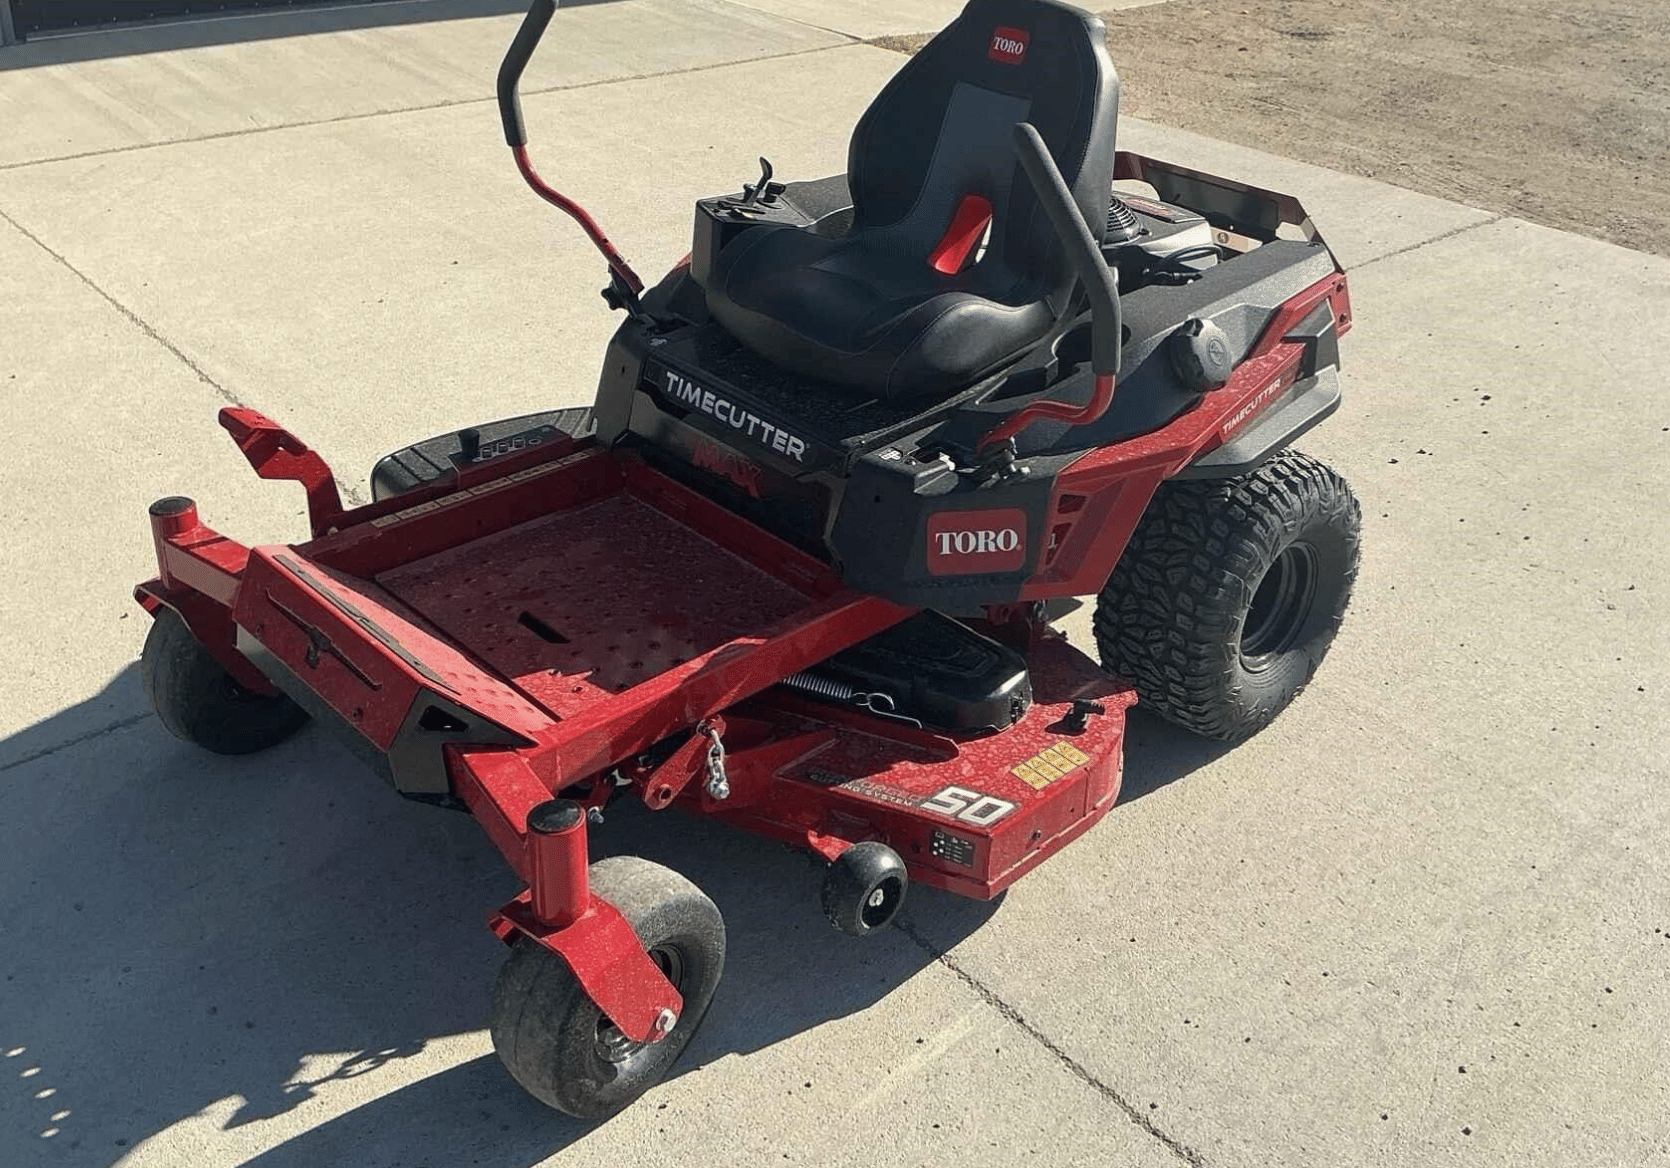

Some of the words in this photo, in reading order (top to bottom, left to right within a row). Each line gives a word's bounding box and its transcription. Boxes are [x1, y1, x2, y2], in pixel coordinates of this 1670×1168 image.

[993, 36, 1024, 55] TORO
[666, 370, 806, 463] TIMECUTTER
[1222, 378, 1281, 435] TIMECUTTER
[935, 528, 1019, 555] TORO
[920, 786, 1015, 826] 50
